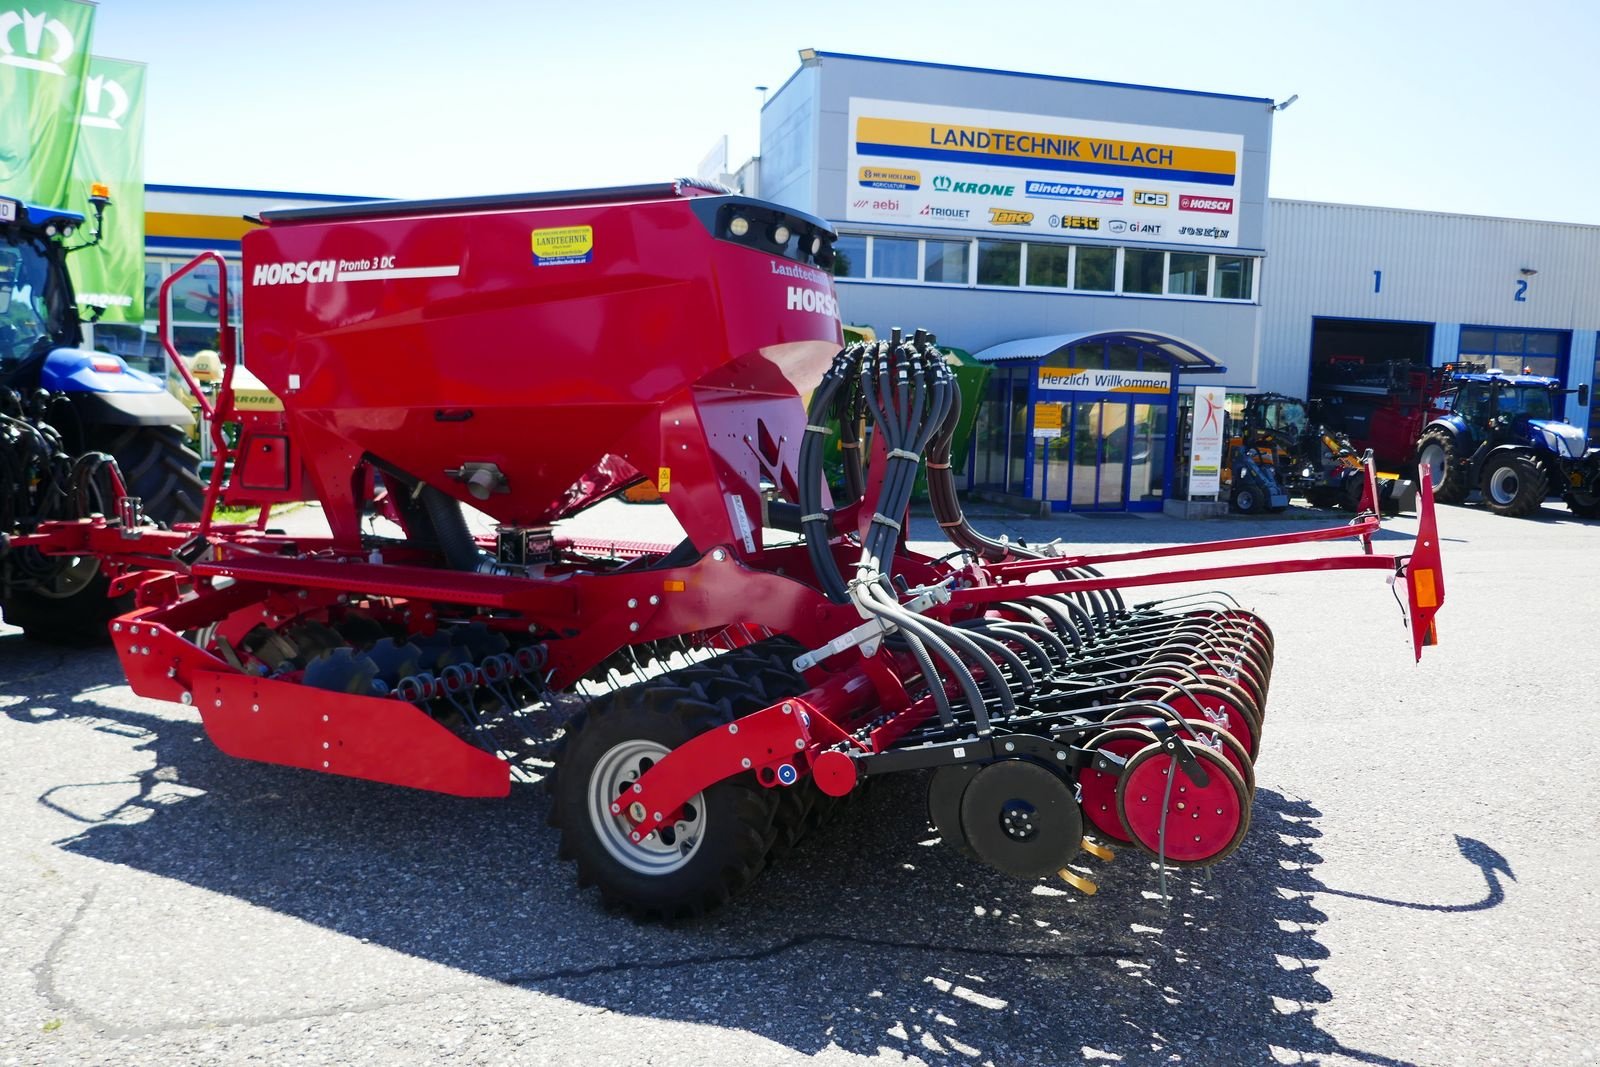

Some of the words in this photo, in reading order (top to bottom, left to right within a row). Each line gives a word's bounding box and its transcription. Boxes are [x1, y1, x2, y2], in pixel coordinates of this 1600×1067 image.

[930, 127, 1081, 158] LANDTECHNIK
[1089, 142, 1174, 166] VILLACH
[888, 173, 916, 182] HOLLAND
[872, 182, 906, 190] AGRICULTURE
[952, 181, 1016, 197] KRONE
[1028, 183, 1122, 200] Binderberger
[873, 199, 899, 211] aebi
[1134, 192, 1168, 206] JCB
[1190, 199, 1231, 211] HORSCH
[988, 207, 1035, 226] Tanco
[536, 234, 587, 246] LANDTECHNIK
[252, 259, 337, 286] HORSCH
[339, 259, 370, 272] Pronto
[371, 257, 379, 270] 3
[380, 255, 396, 269] DC
[1373, 270, 1382, 293] 1
[1514, 279, 1528, 302] 2
[1041, 373, 1090, 387] Herzlich
[1094, 374, 1168, 389] Willkommen
